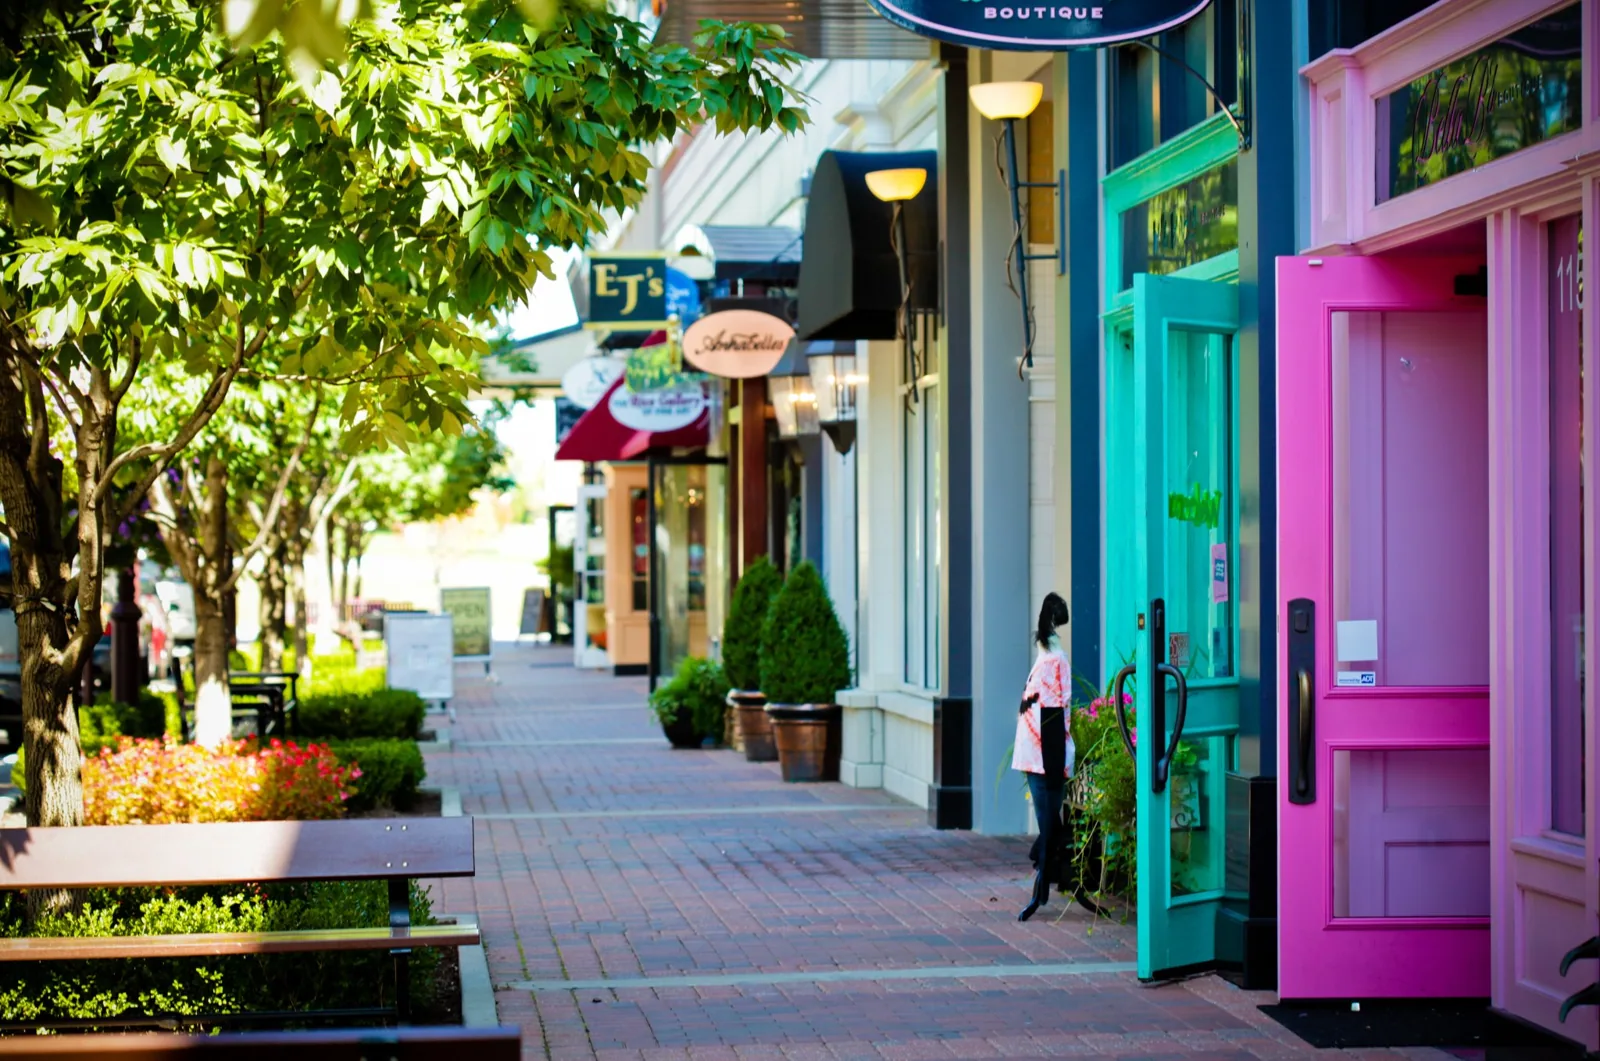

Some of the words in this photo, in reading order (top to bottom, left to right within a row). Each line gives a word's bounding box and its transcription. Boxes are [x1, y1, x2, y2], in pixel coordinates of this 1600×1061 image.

[984, 7, 1103, 19] BOUTIQUE
[592, 263, 664, 316] EJ's
[1361, 675, 1374, 683] ADT
